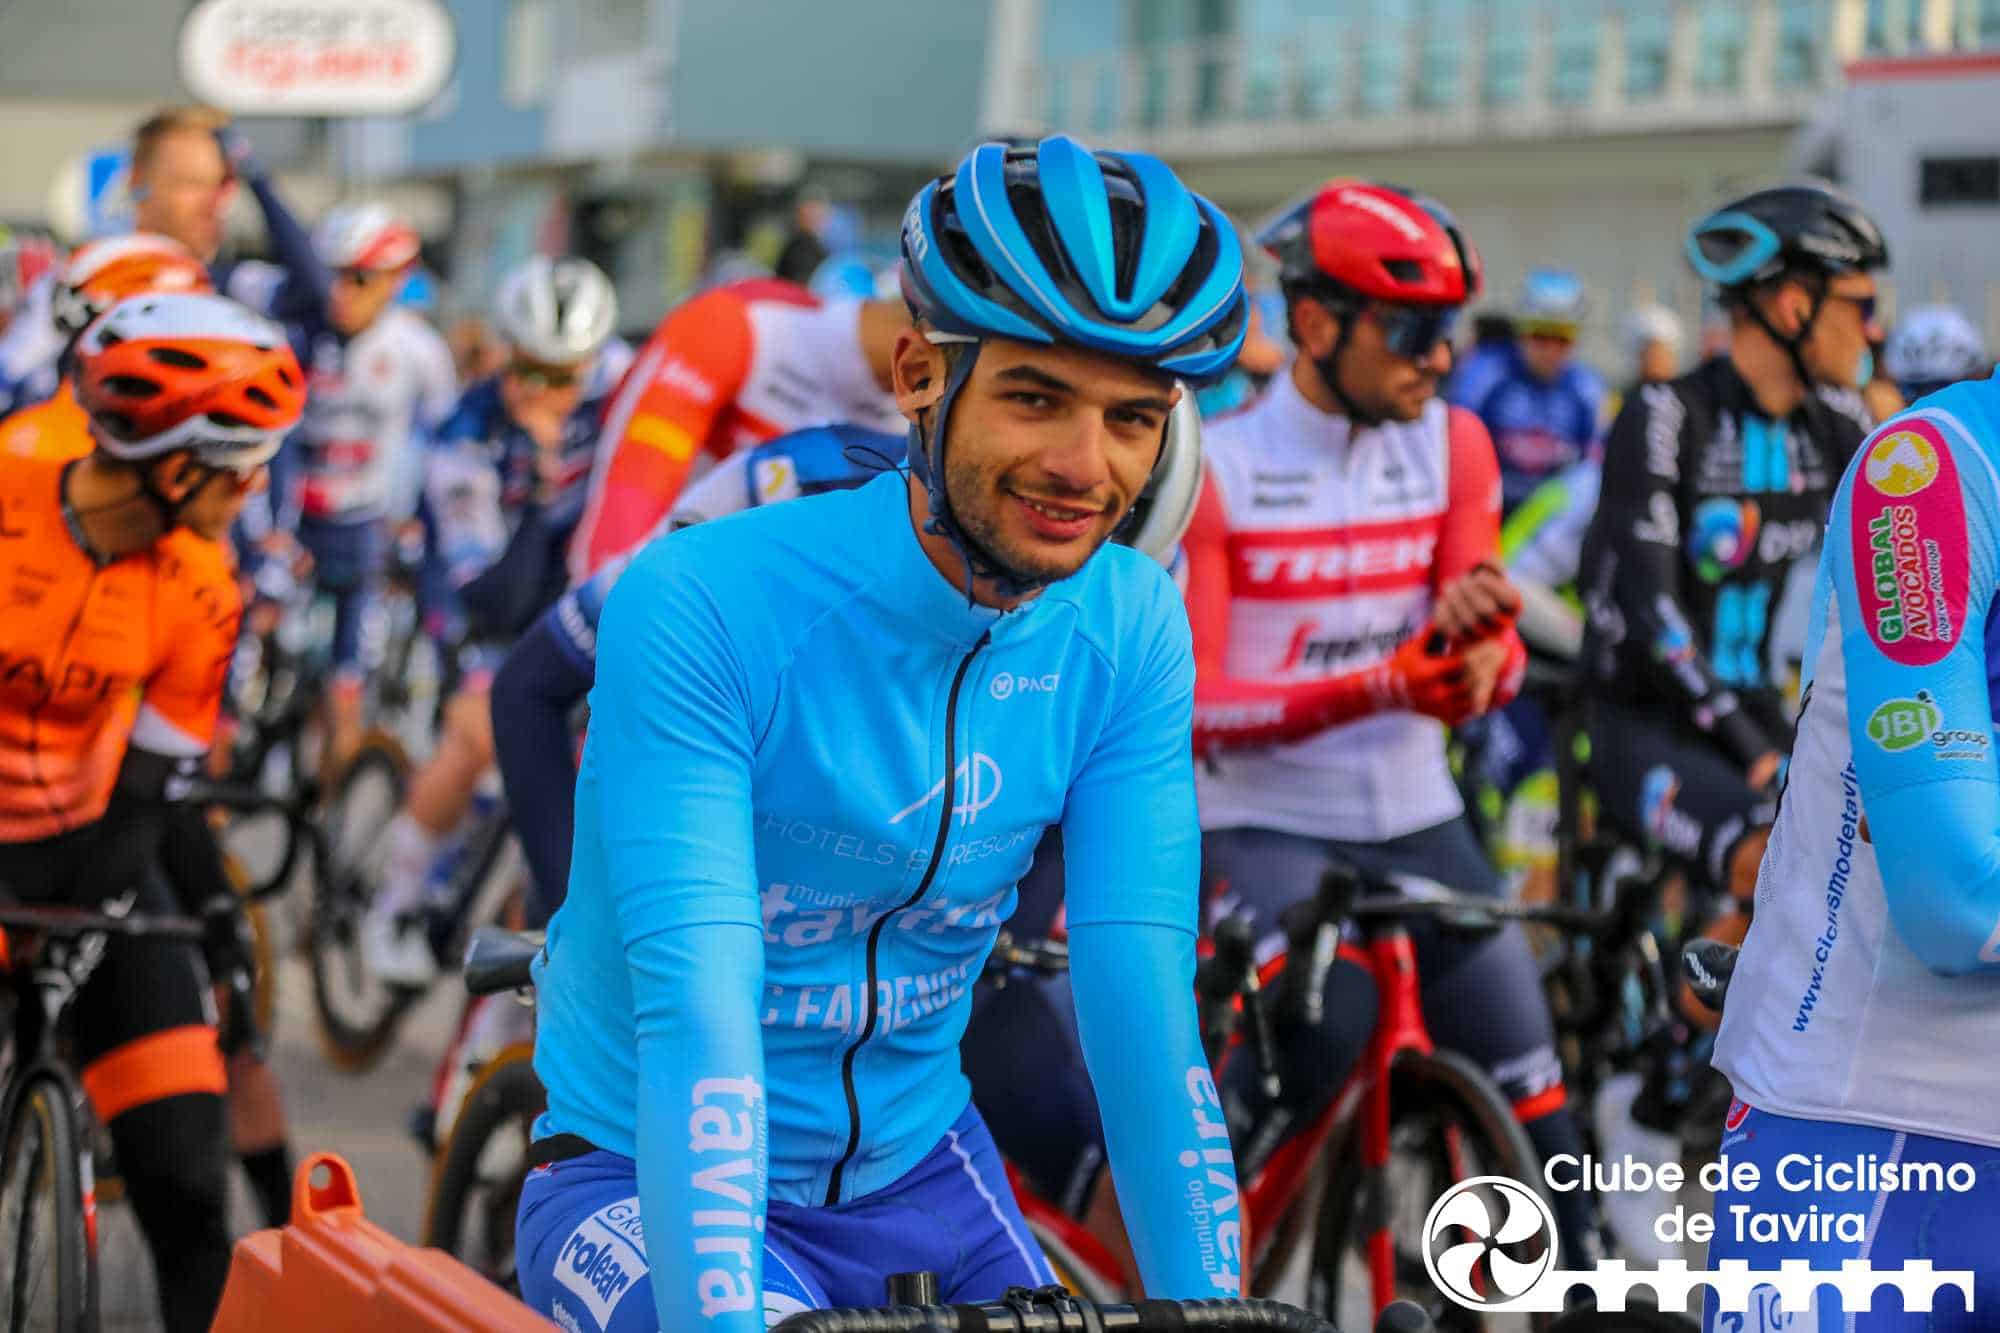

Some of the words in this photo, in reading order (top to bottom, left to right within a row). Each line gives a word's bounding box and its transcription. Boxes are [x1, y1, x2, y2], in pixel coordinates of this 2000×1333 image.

[1241, 535, 1438, 583] TREK
[1870, 506, 1905, 643] GLOBAL
[1893, 505, 1933, 640] AVOCADOS
[765, 811, 898, 866] HOTELS
[689, 1074, 765, 1319] tavira
[561, 1231, 631, 1304] rolear
